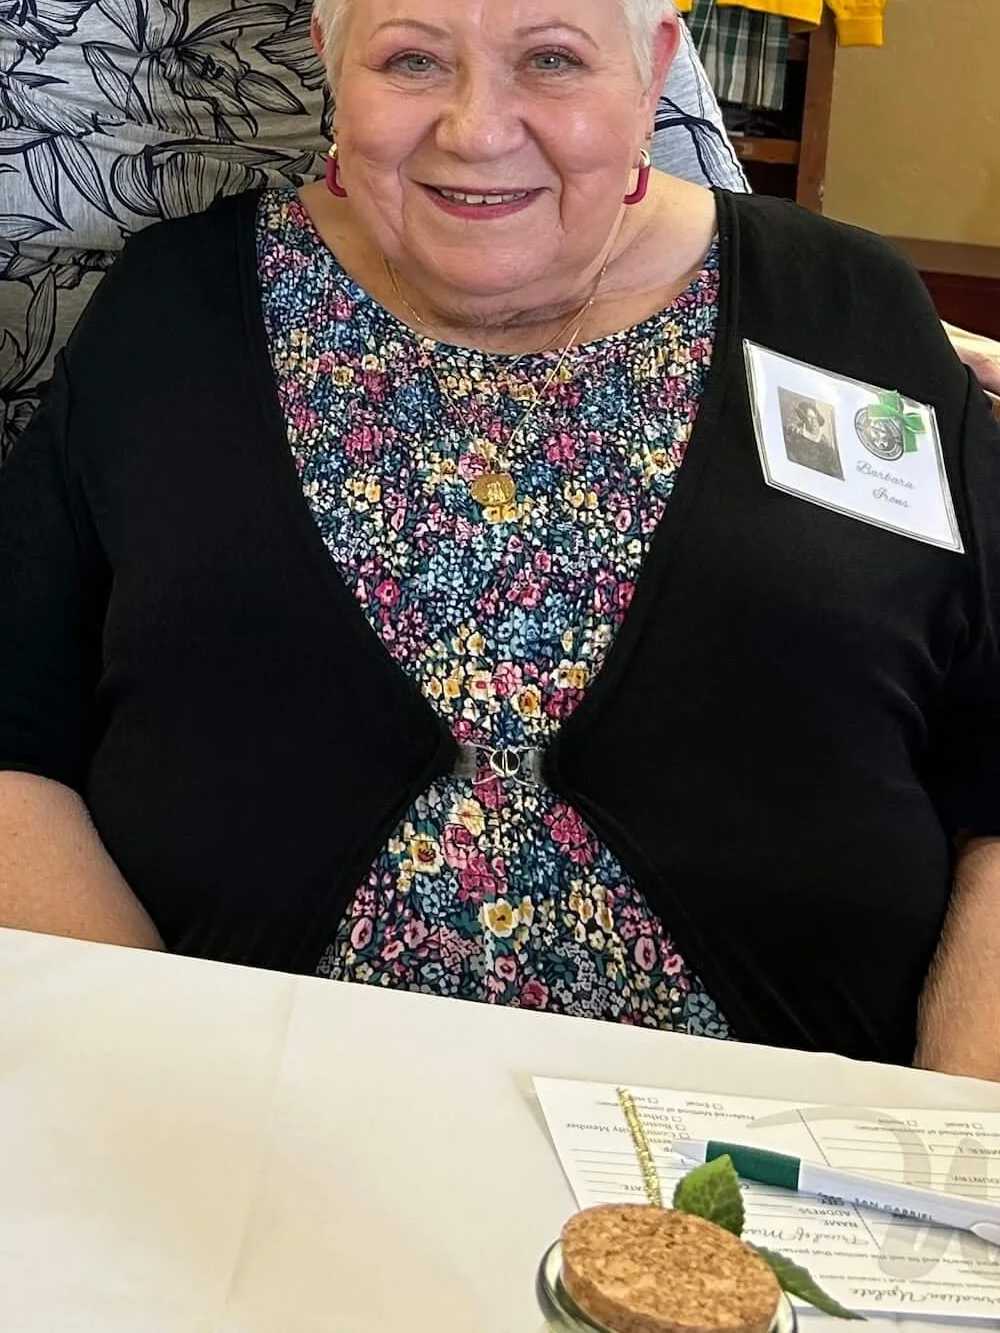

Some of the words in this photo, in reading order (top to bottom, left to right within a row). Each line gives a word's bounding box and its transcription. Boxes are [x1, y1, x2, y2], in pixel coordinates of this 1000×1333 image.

[856, 460, 915, 490] Barbara
[565, 1122, 610, 1133] Member
[848, 1286, 928, 1303] Update
